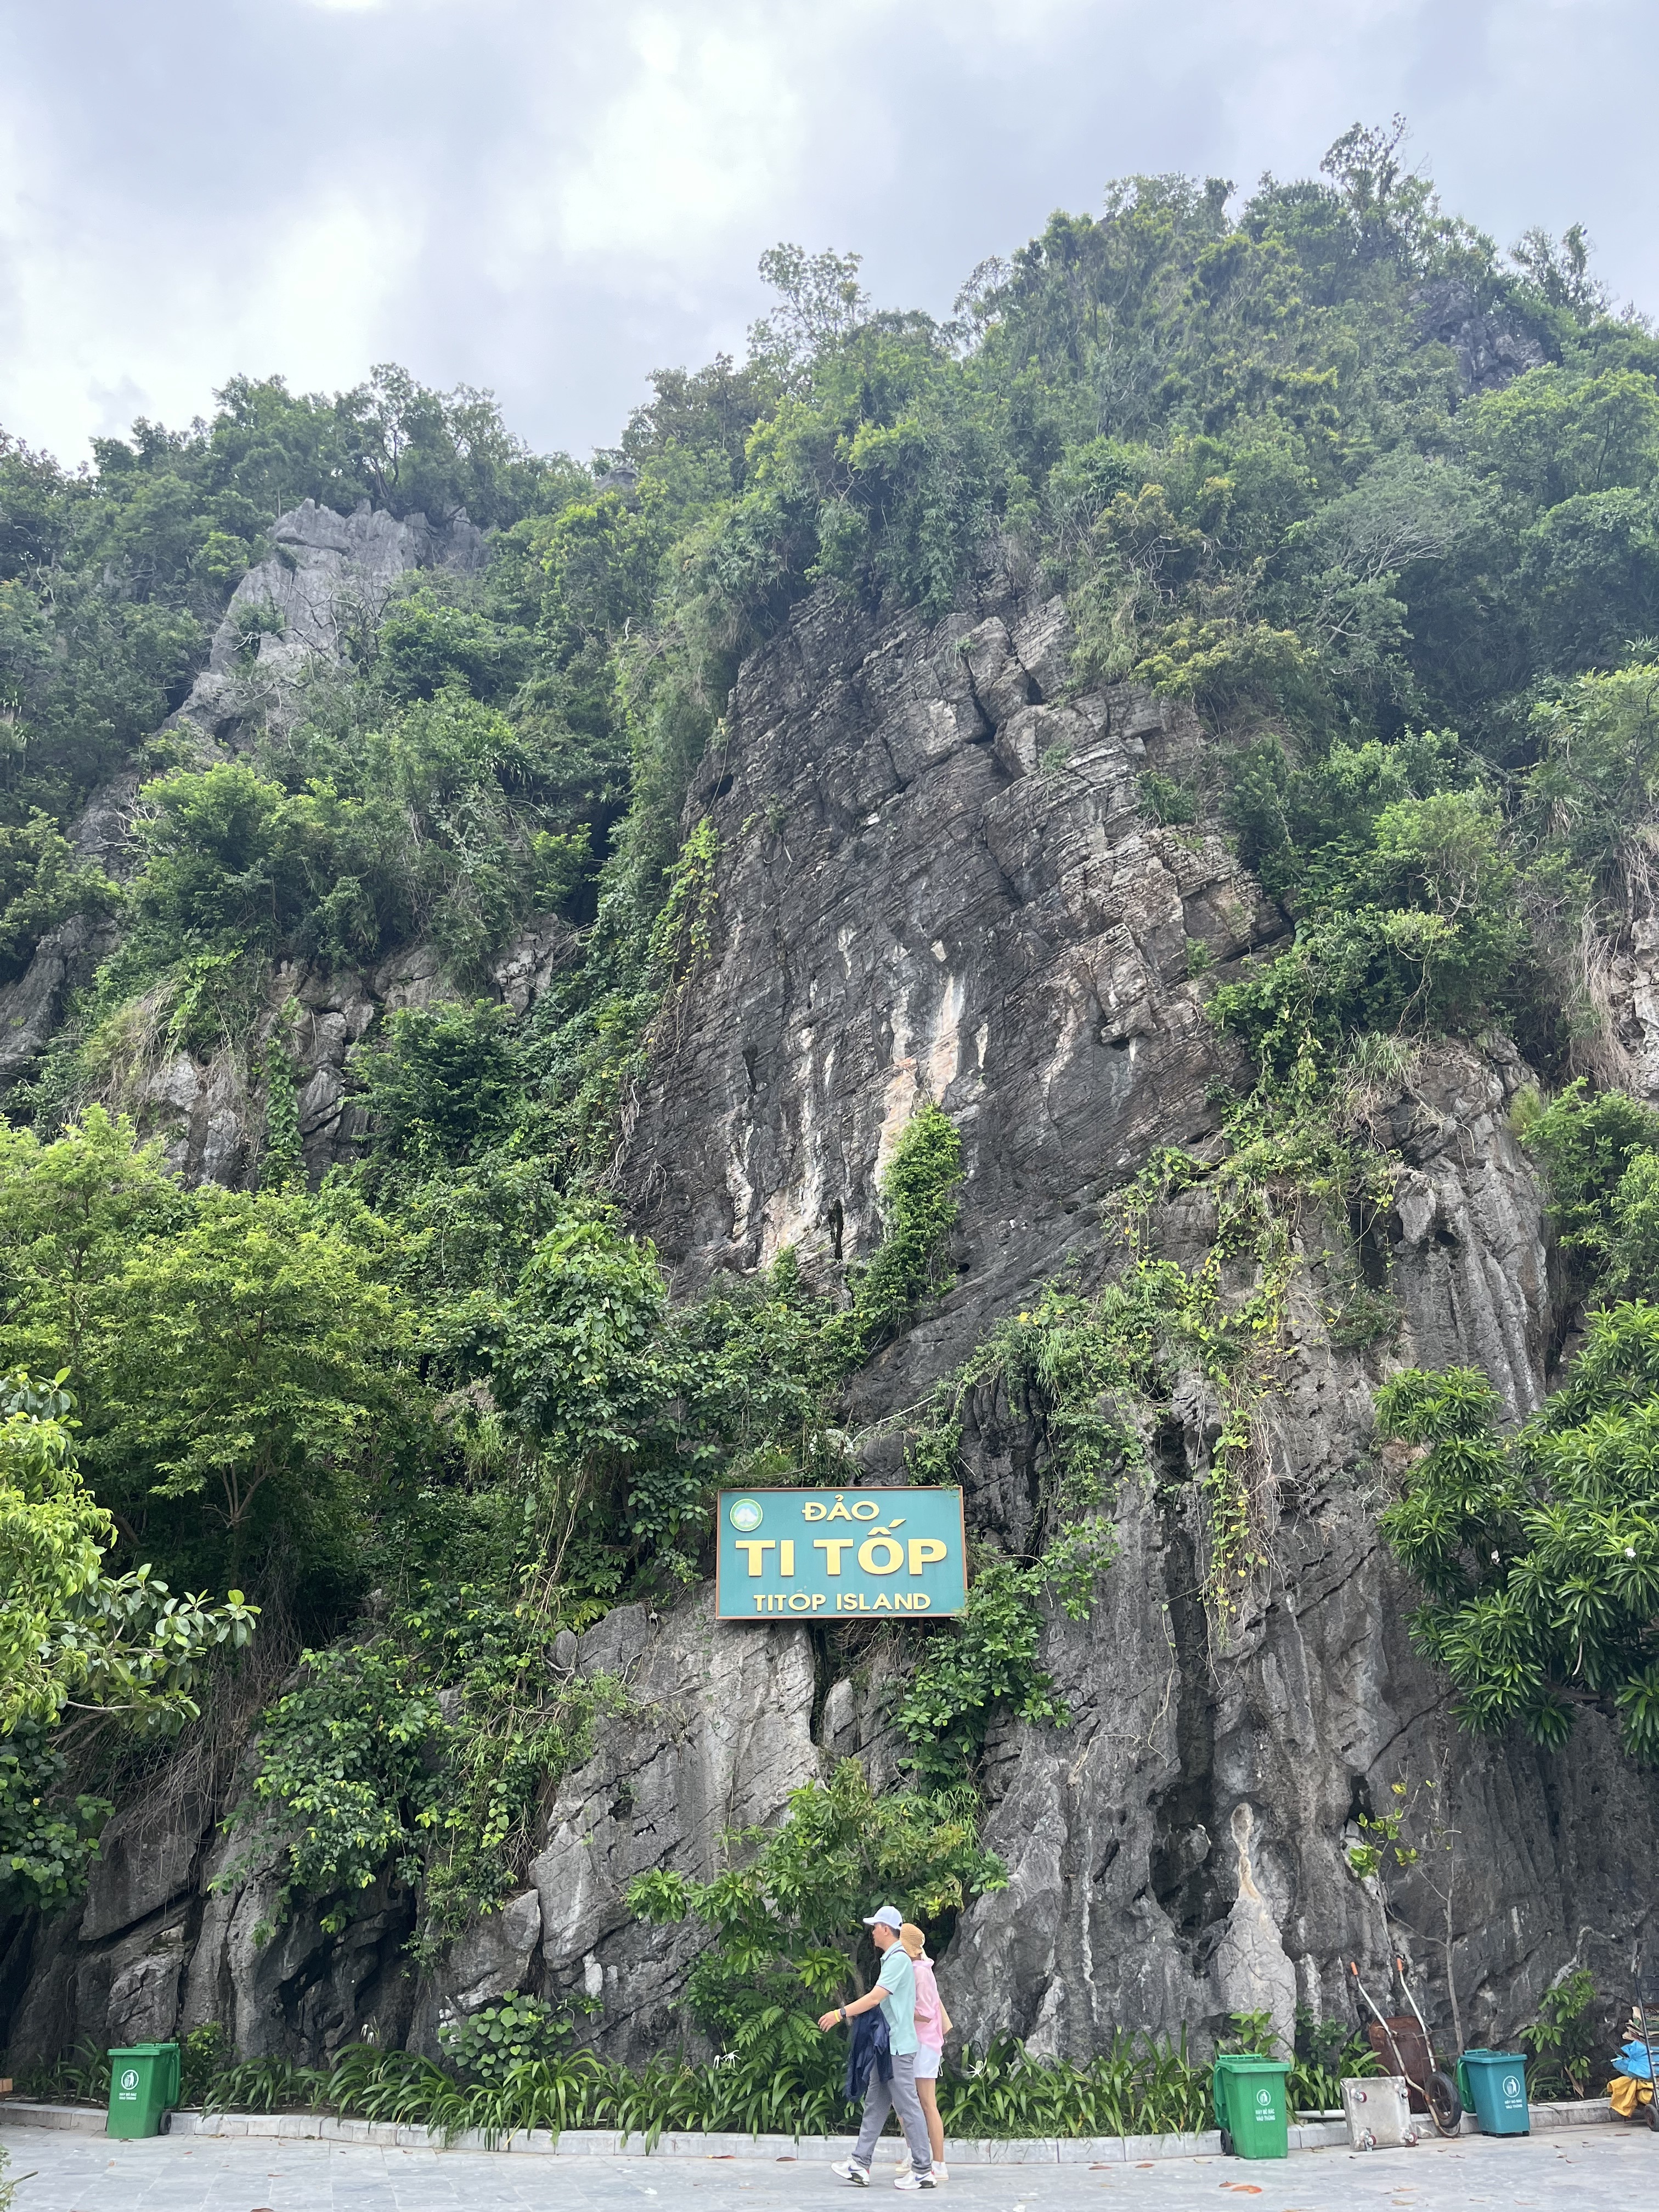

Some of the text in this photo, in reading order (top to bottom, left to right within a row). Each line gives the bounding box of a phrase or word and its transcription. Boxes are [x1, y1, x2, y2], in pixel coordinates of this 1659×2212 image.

[802, 1494, 880, 1521] ĐẢO
[735, 1518, 947, 1576] TI TỐP
[837, 1593, 932, 1611] ISLAND
